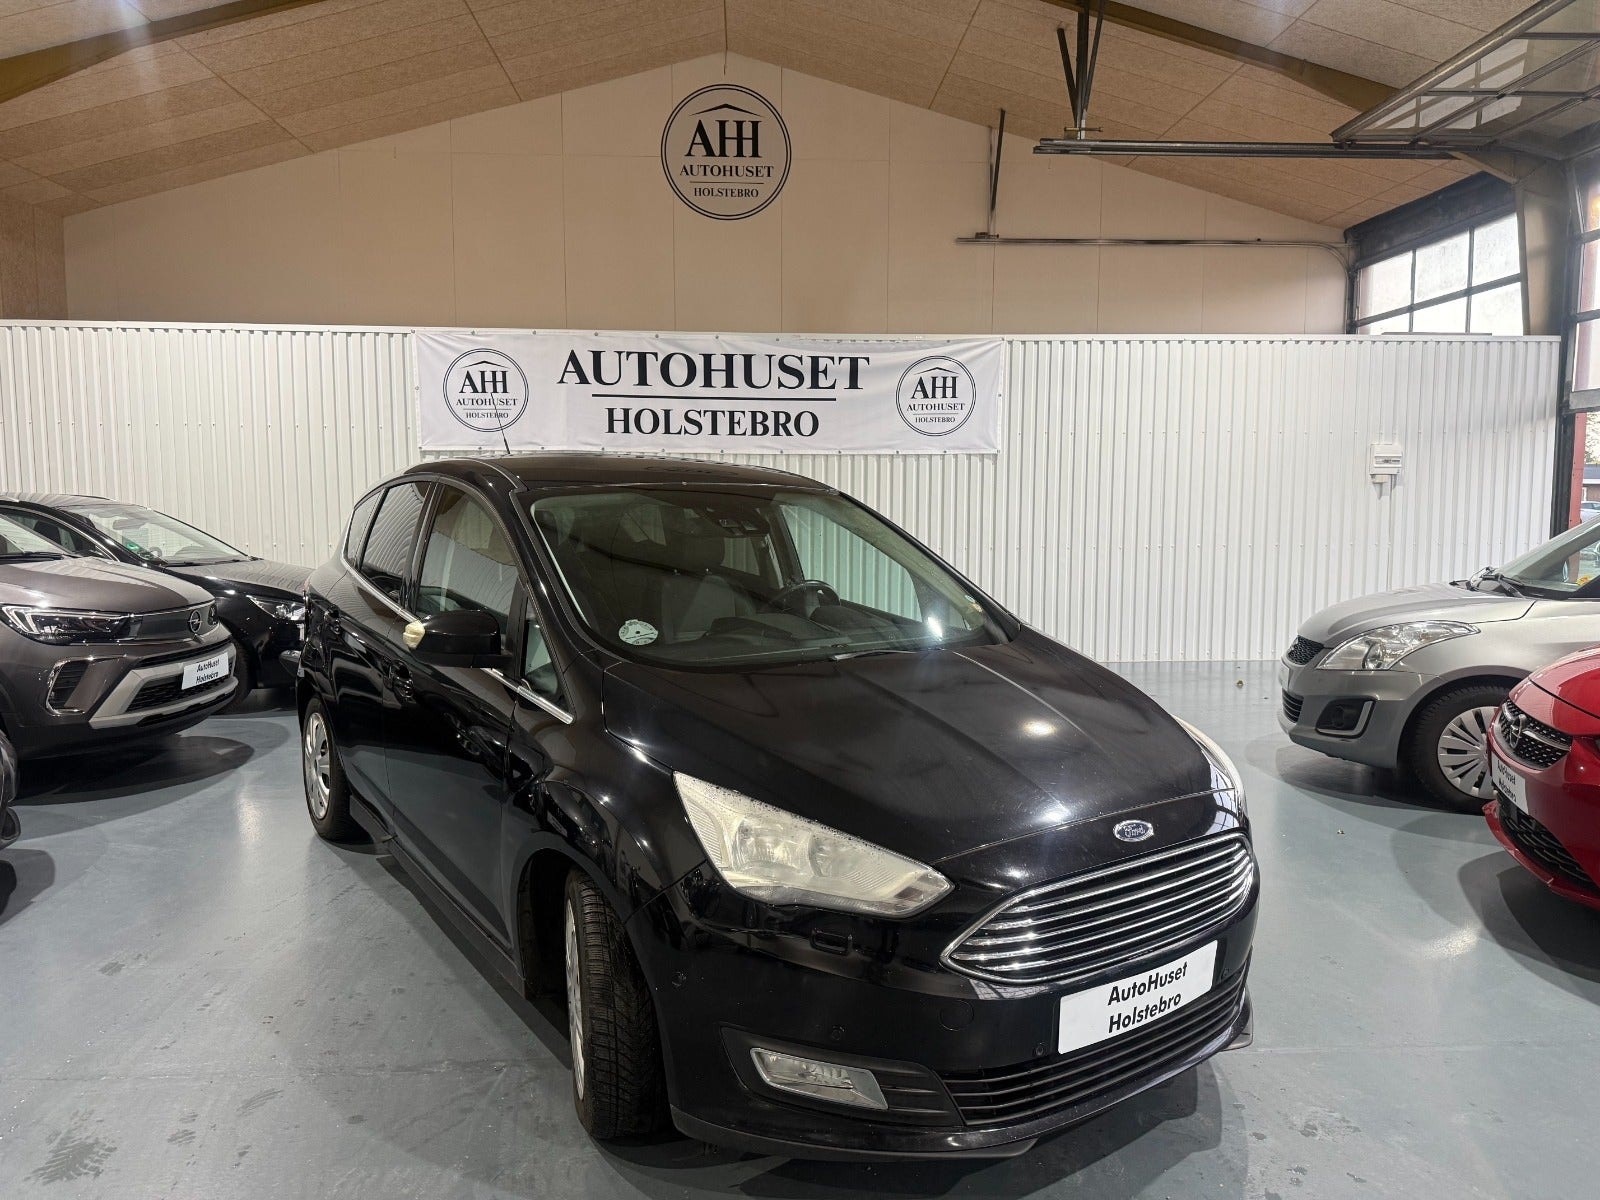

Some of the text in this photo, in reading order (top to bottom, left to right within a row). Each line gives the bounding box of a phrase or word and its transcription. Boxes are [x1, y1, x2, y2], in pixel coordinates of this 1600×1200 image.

[680, 164, 775, 178] AUTOHUSET
[694, 187, 759, 198] HOLSTEBRO
[556, 349, 871, 391] AUTOHUSET
[456, 398, 518, 406] AUTOHUSET
[907, 403, 966, 412] AUTOHUSET
[605, 407, 820, 437] HOLSTEBRO
[1107, 961, 1188, 1006] AutoHuset
[1108, 992, 1182, 1034] Holstebro
